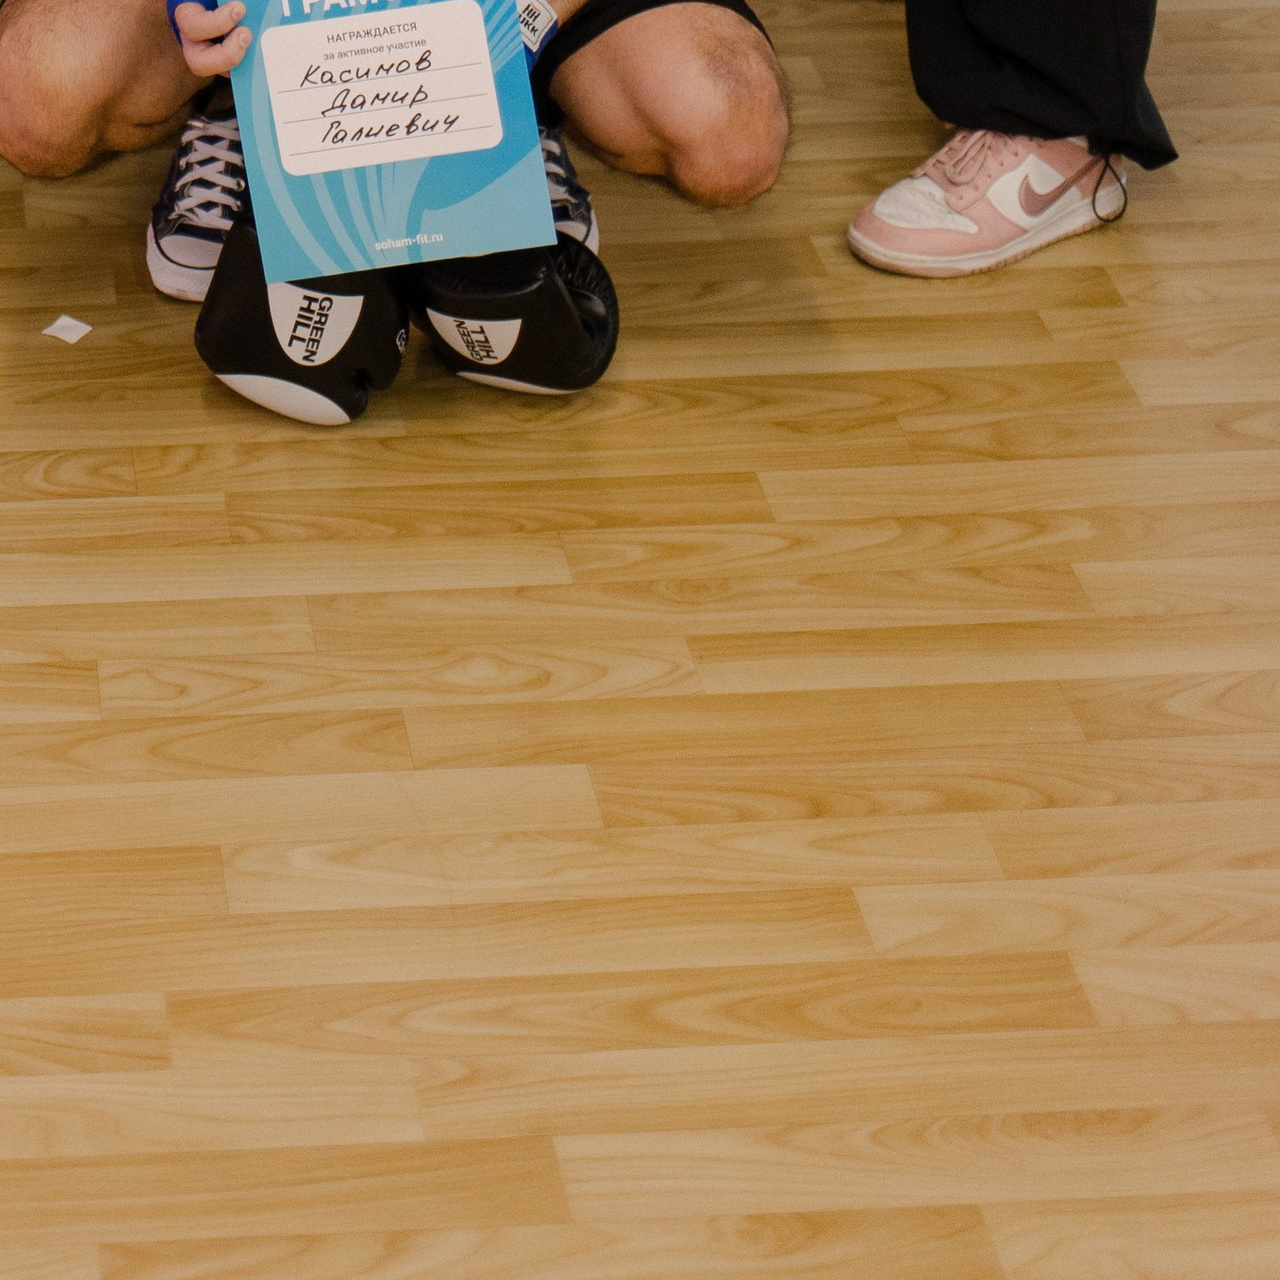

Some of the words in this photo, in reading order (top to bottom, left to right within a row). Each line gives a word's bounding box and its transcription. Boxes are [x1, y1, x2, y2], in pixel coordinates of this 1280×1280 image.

[326, 21, 418, 44] НАГРАЖДАЕТСЯ
[518, 14, 539, 37] UKK
[322, 51, 334, 61] за
[336, 43, 385, 60] активное
[386, 38, 427, 56] участие
[299, 48, 434, 89] Касимов
[320, 84, 430, 118] Дамир
[321, 111, 461, 145] Галиевич
[374, 232, 444, 252] soham-fit.ru
[287, 294, 320, 347] HILL
[302, 296, 334, 363] GREEN
[453, 319, 484, 361] GREEN
[470, 325, 498, 360] HILL
